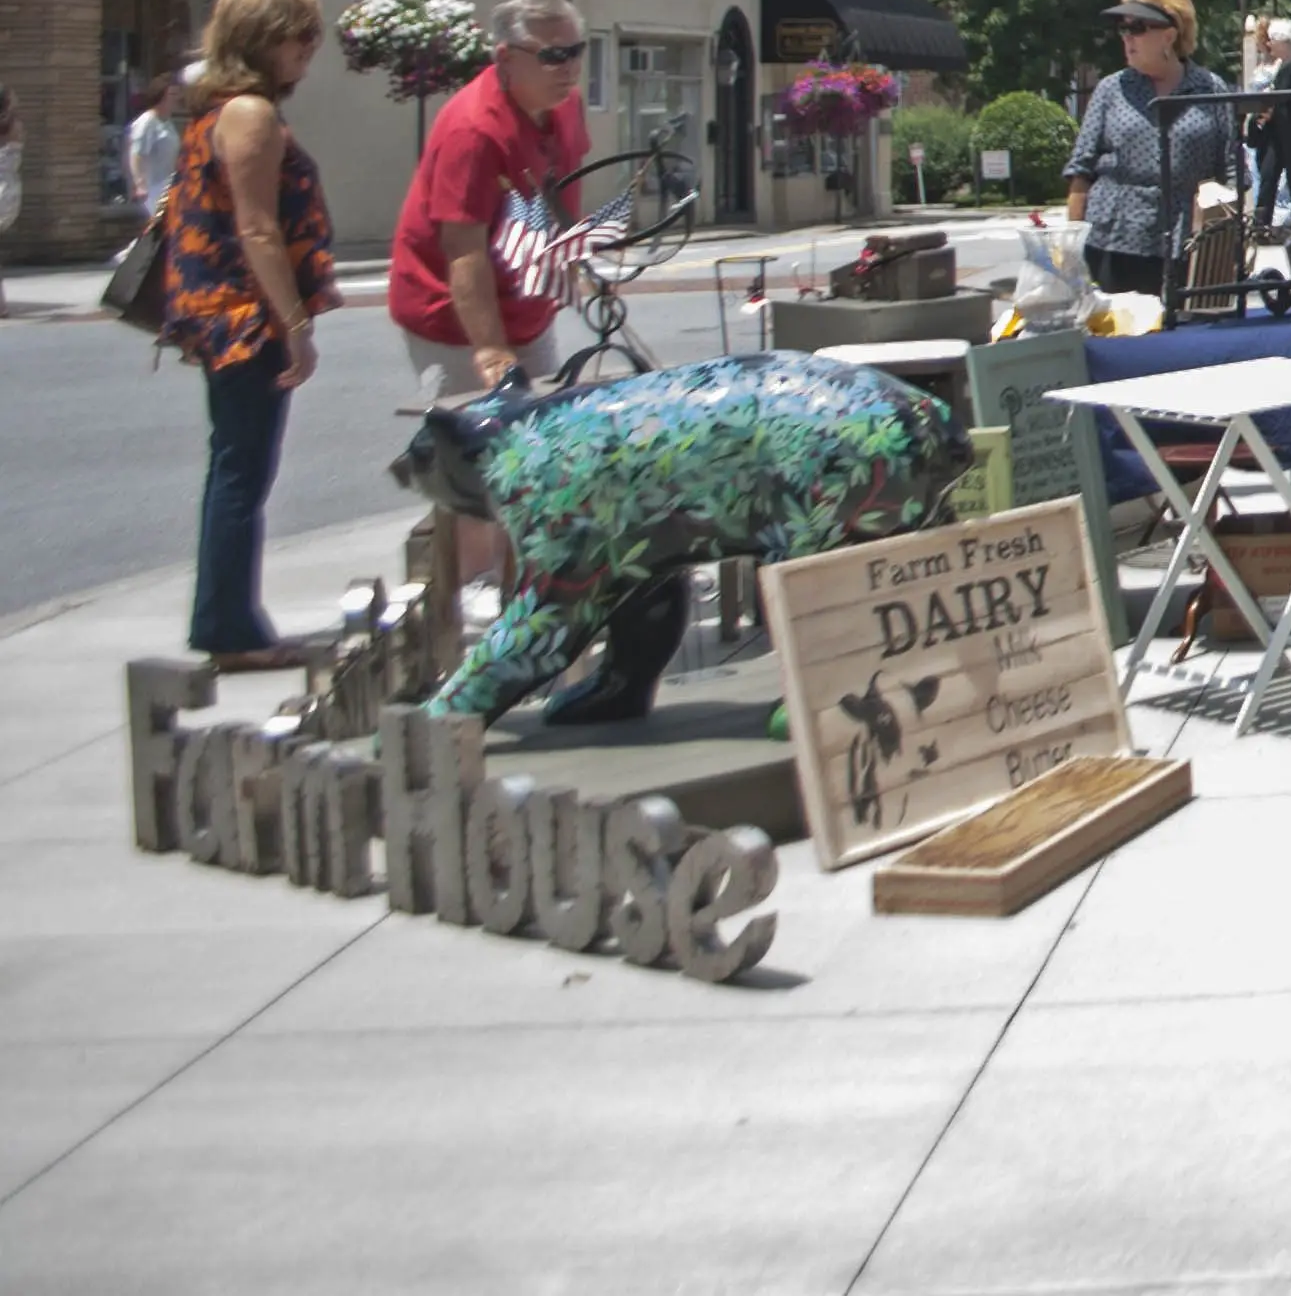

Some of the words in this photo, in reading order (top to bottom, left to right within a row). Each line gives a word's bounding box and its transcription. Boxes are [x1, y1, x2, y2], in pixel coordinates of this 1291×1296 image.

[867, 554, 951, 591] Farm
[958, 527, 1044, 570] Fresh
[872, 565, 1050, 660] DAIRY
[985, 681, 1072, 734] Cheese
